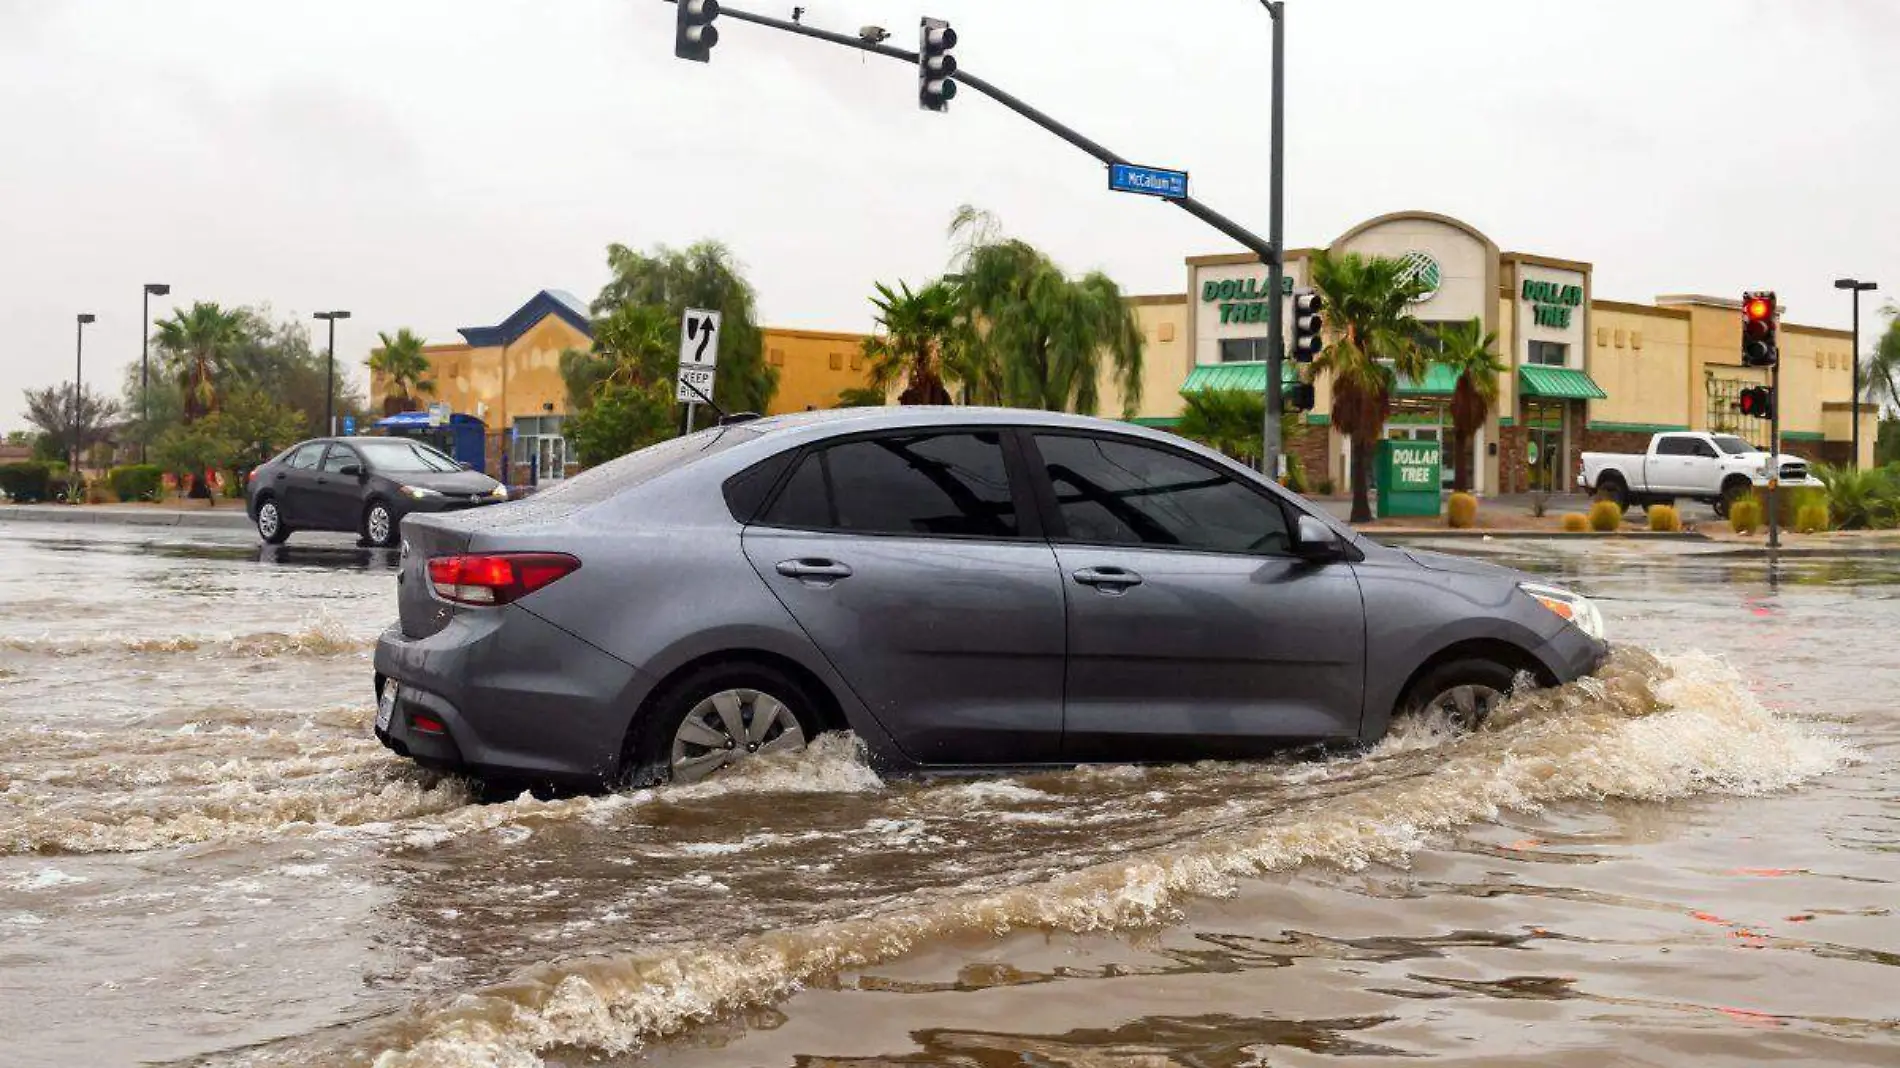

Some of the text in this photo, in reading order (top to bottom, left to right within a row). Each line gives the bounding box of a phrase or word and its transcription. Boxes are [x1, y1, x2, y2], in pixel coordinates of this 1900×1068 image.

[1128, 172, 1169, 190] McCallum
[1522, 279, 1583, 306] DOLLAR
[1533, 303, 1571, 329] TREE
[684, 372, 709, 384] KEEP
[1393, 448, 1438, 465] DOLLAR
[1401, 466, 1430, 482] TREE
